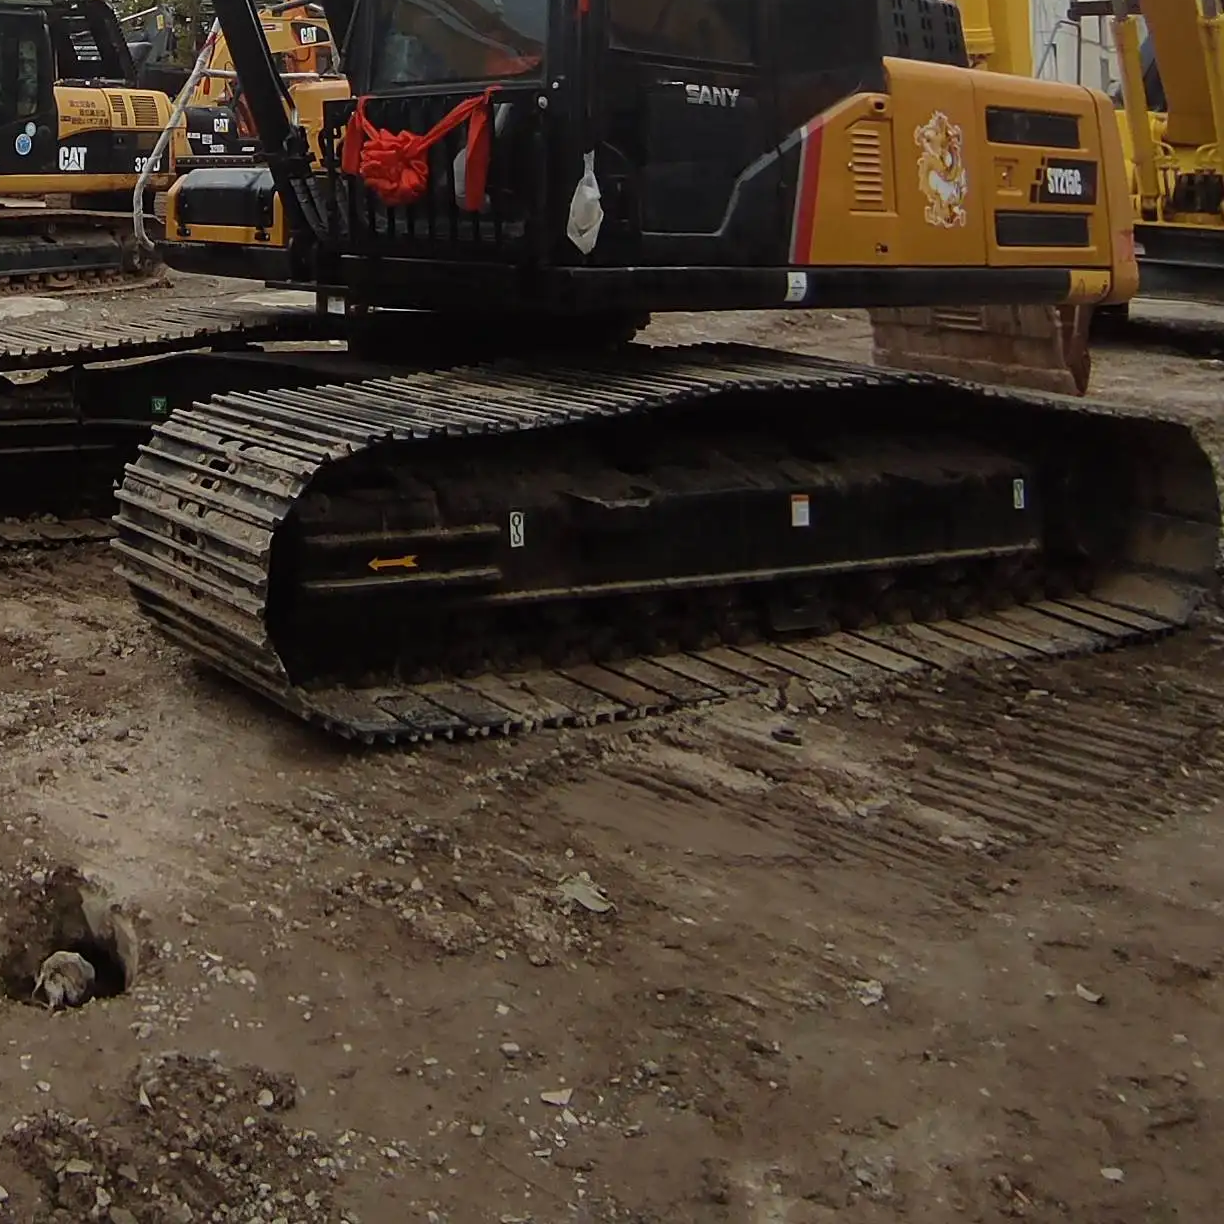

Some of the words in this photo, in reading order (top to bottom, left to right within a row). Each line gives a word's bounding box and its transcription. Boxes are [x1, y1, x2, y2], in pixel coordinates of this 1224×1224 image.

[300, 26, 317, 44] CAT
[685, 84, 741, 108] SANY
[213, 118, 230, 133] CAT
[59, 146, 88, 171] CAT
